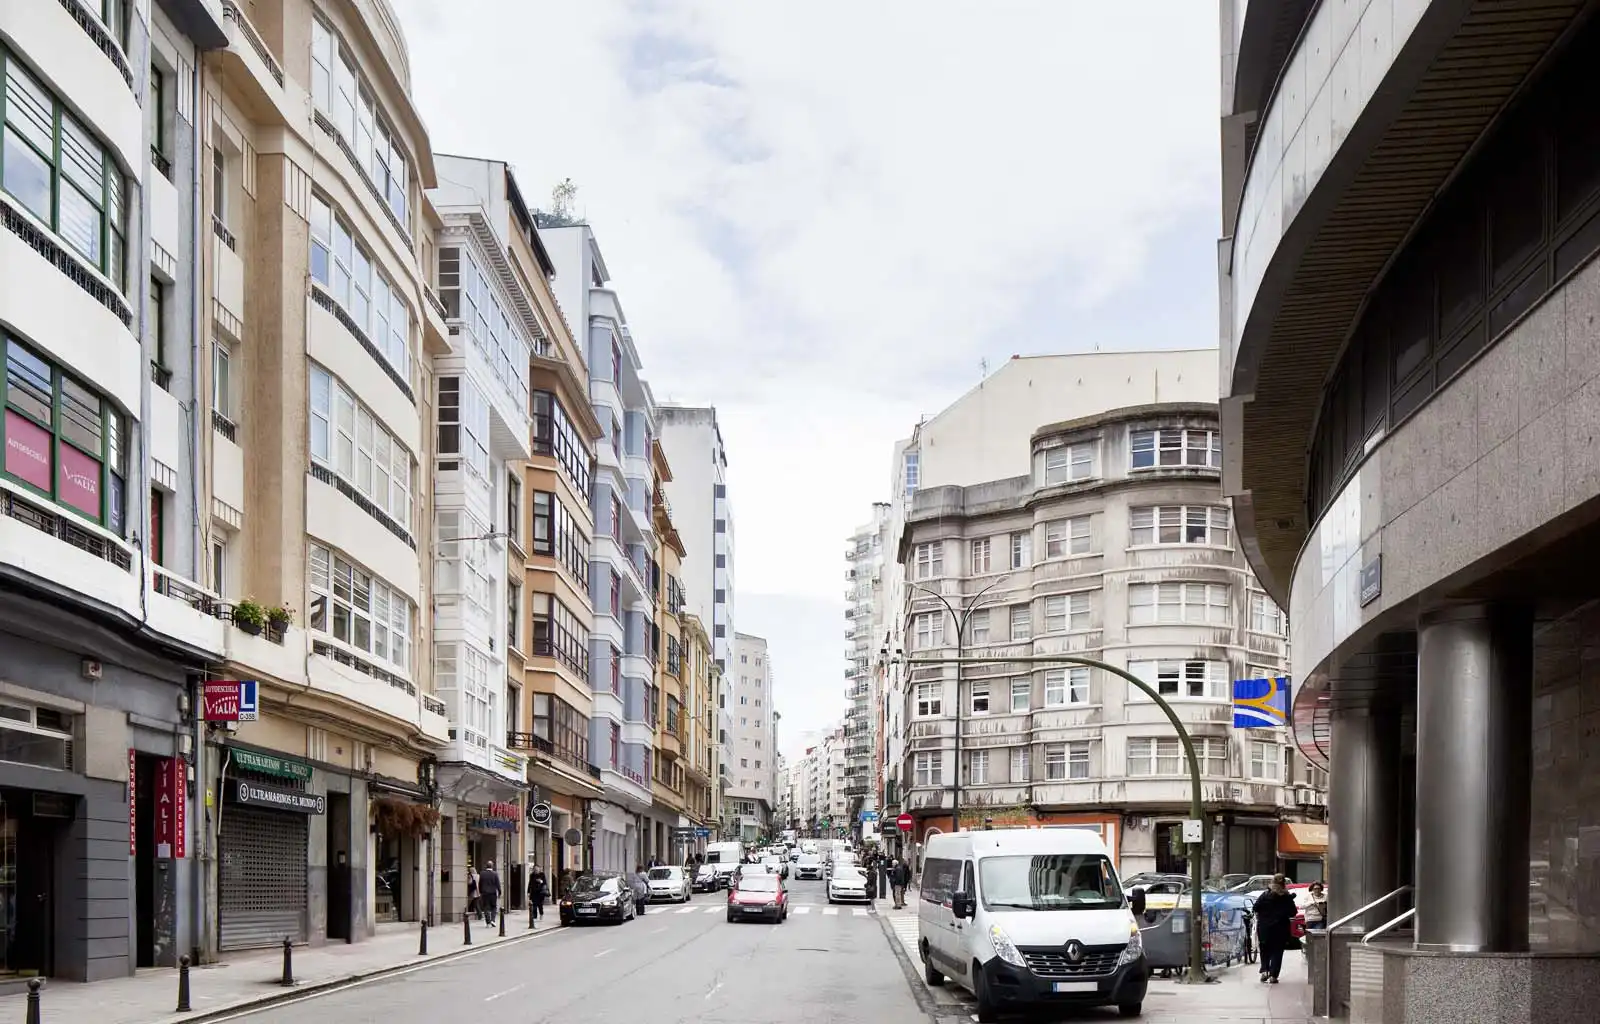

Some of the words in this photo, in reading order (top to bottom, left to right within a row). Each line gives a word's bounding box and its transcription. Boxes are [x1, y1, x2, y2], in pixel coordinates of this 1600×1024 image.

[8, 438, 47, 464] AUTOESCUELA
[241, 684, 254, 708] L
[236, 752, 280, 769] ULTRAMARINOS
[249, 787, 292, 805] ULTRAMARINOS
[292, 794, 299, 806] EL
[299, 796, 317, 809] MUNDO
